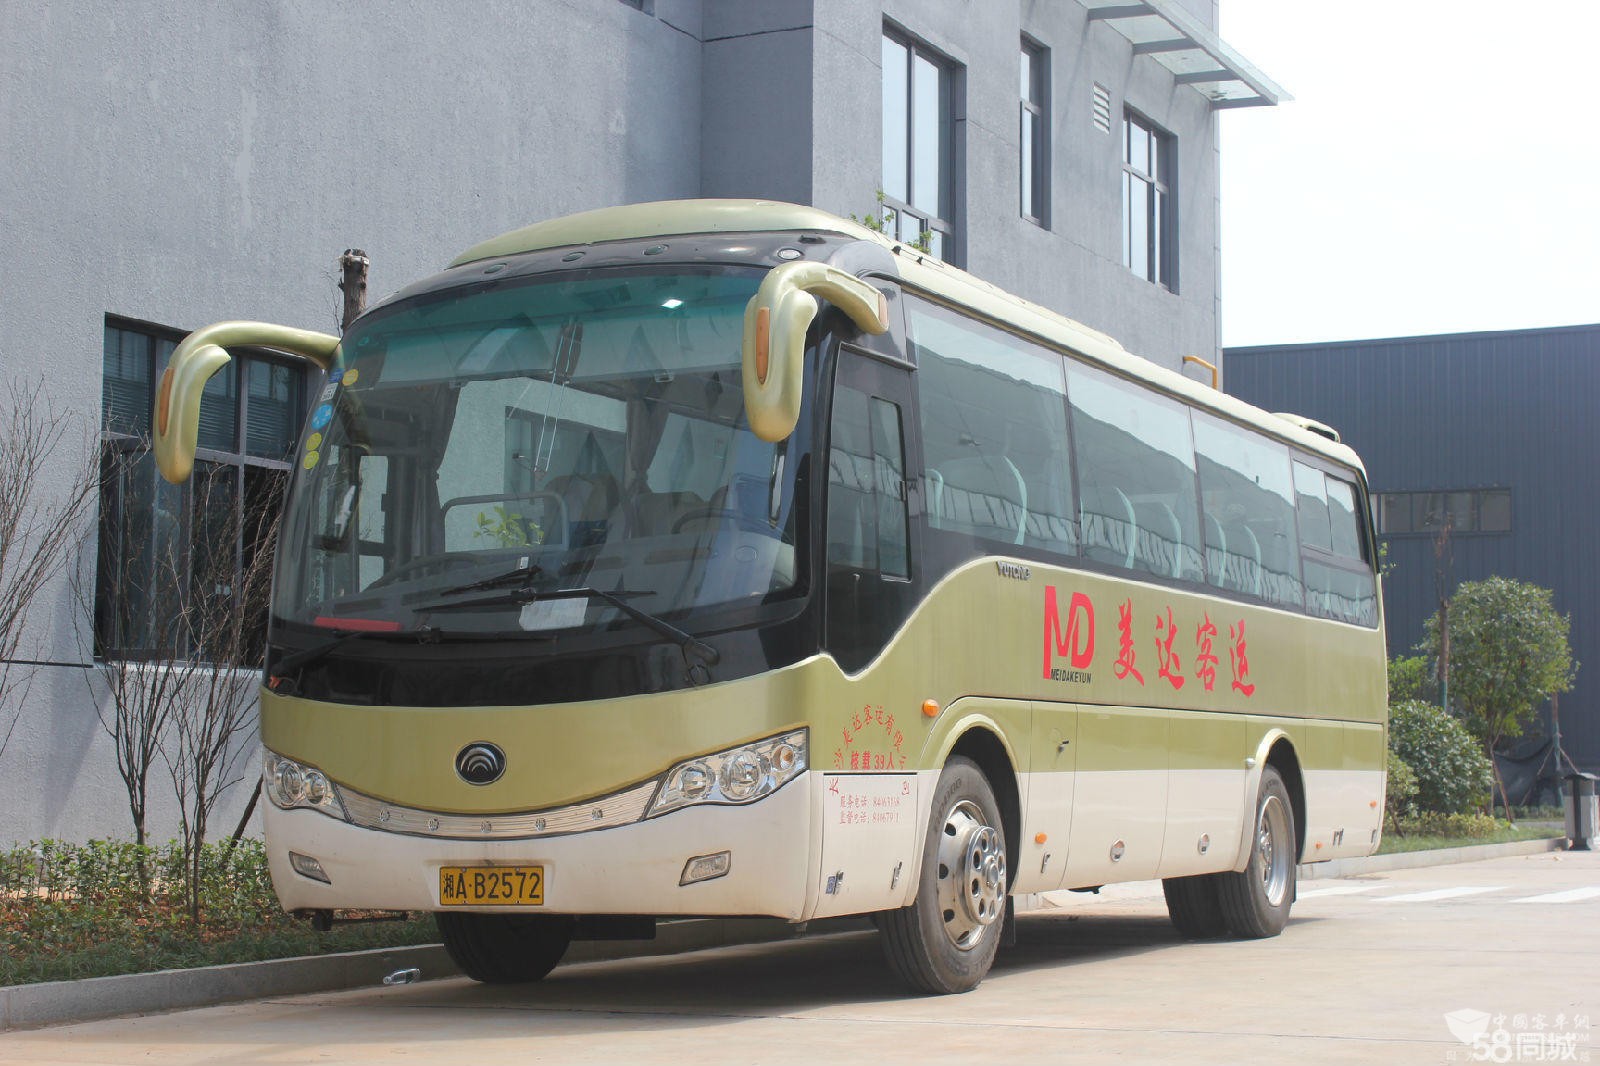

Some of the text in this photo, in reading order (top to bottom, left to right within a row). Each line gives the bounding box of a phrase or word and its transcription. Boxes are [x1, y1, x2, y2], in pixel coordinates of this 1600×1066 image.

[1043, 585, 1095, 680] MD
[1050, 668, 1093, 684] MEIDAKEYUN
[1113, 597, 1256, 697] 美达客运
